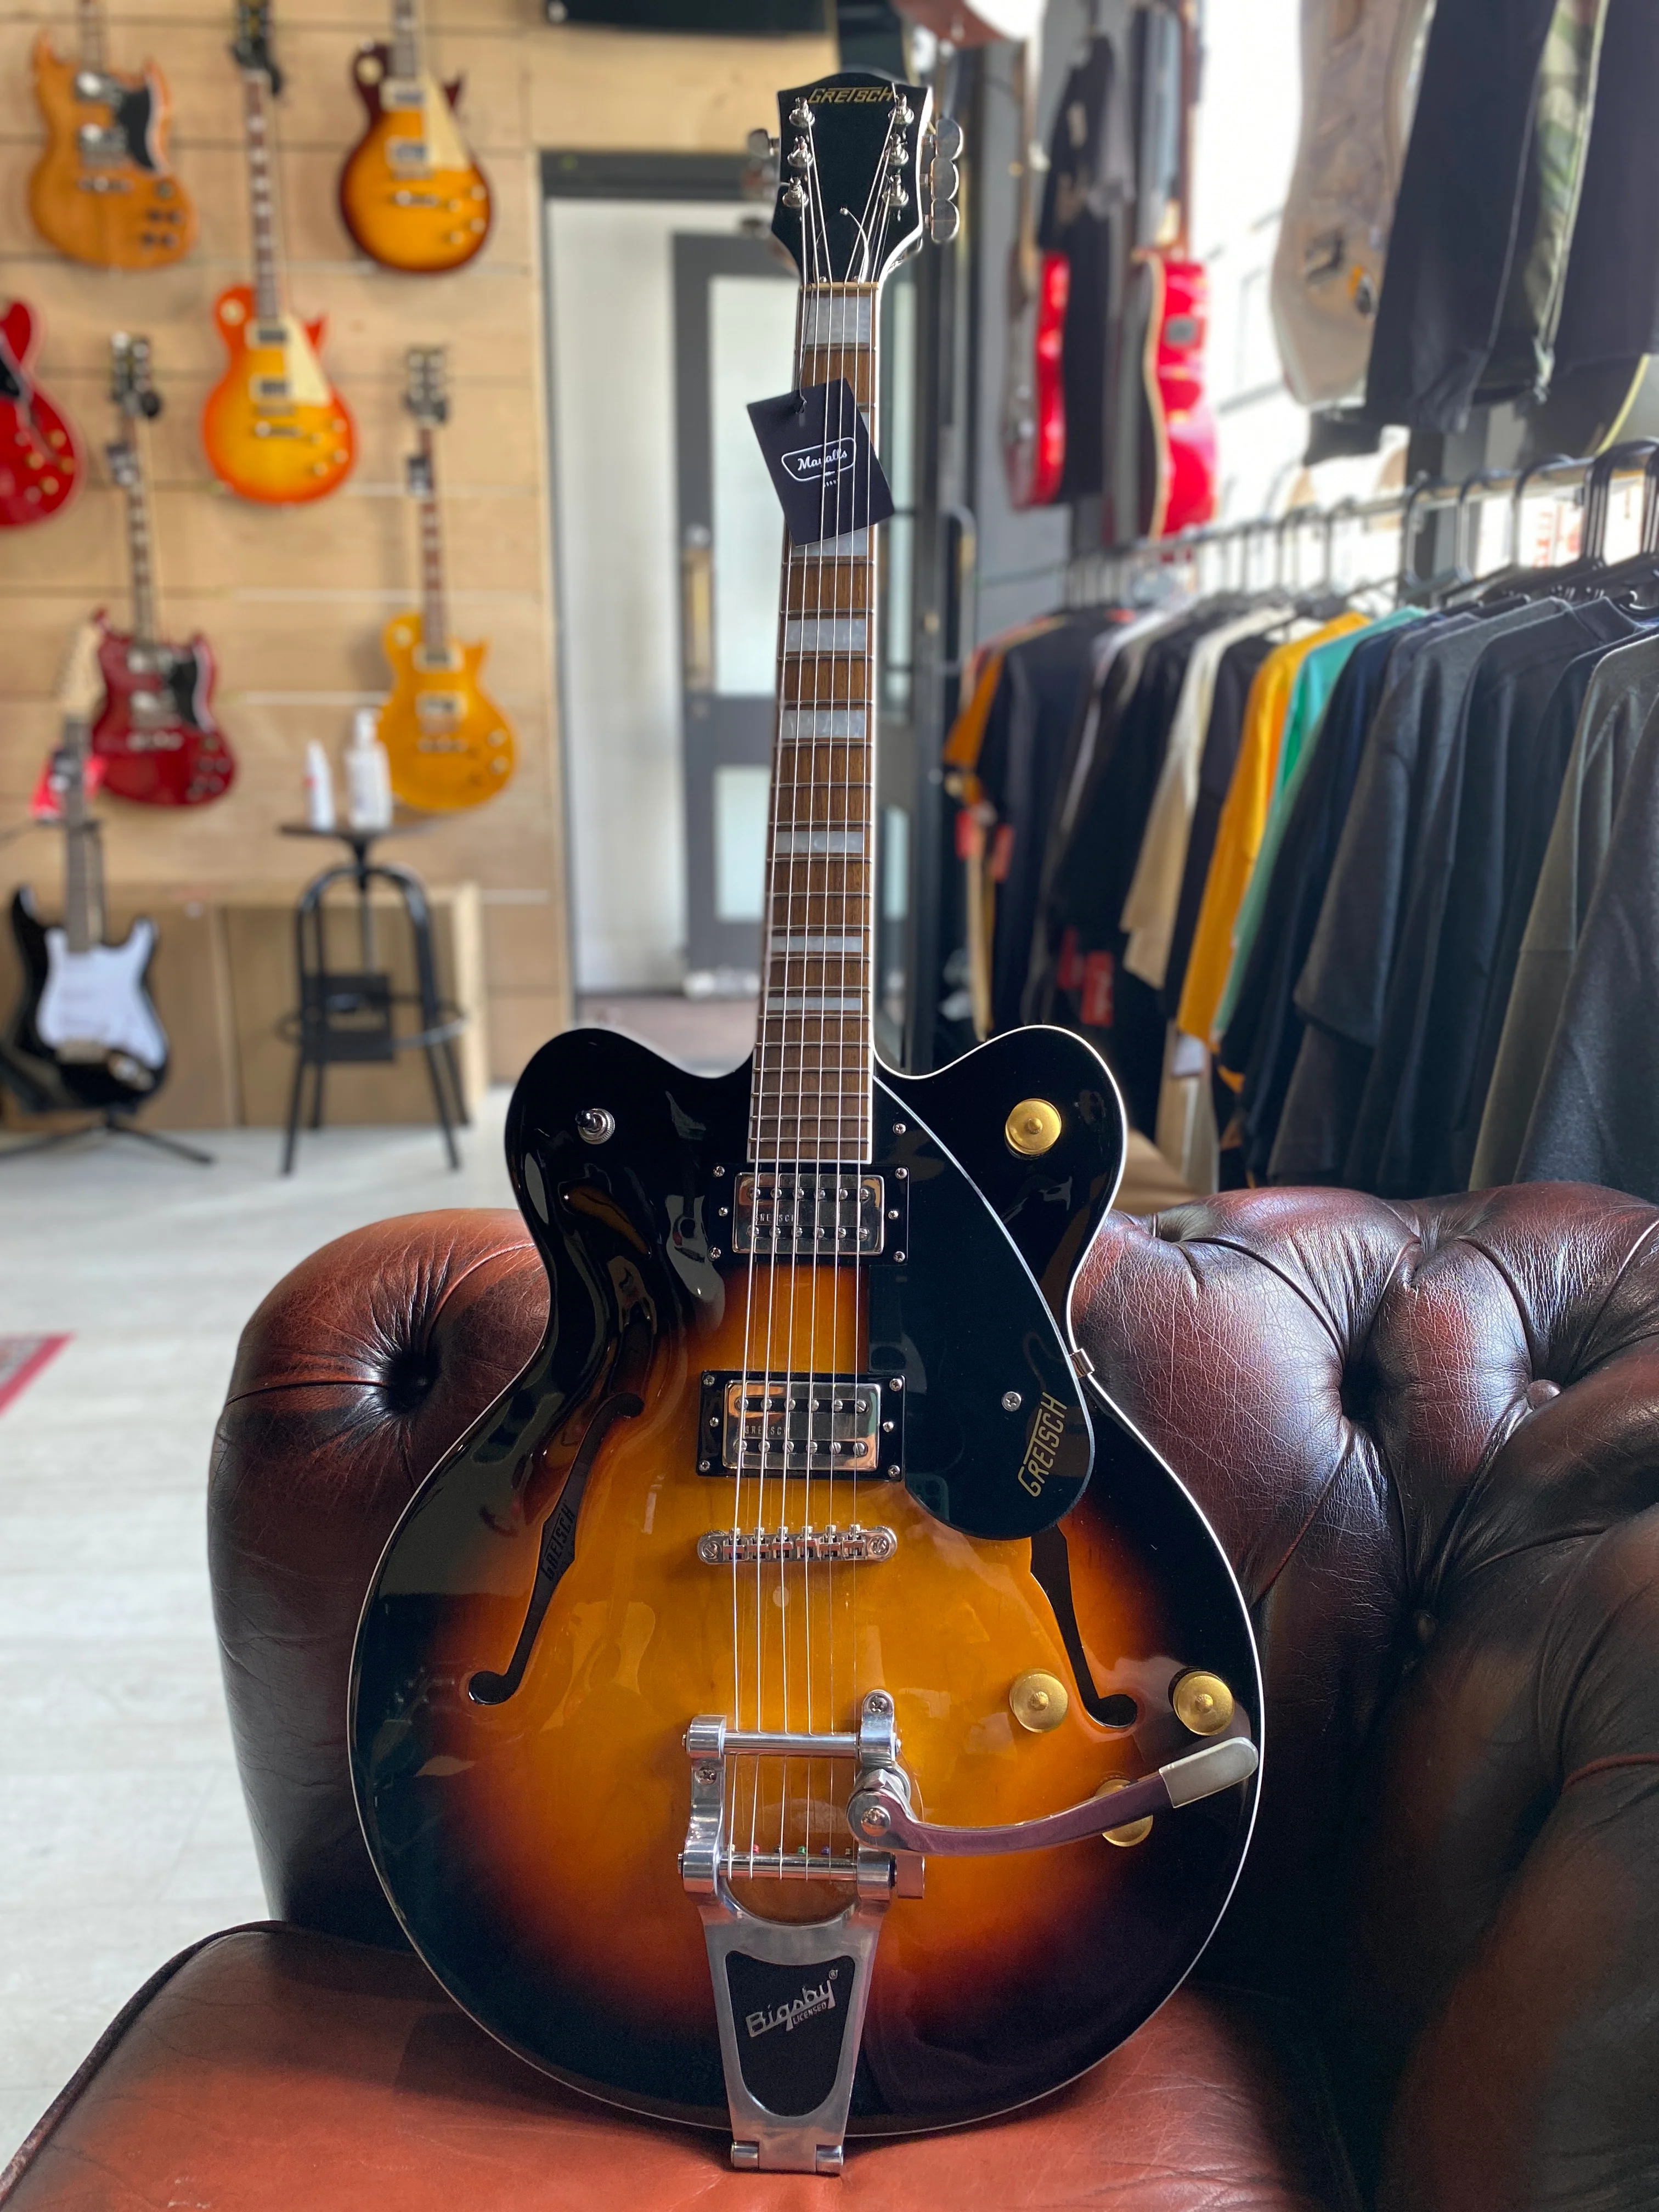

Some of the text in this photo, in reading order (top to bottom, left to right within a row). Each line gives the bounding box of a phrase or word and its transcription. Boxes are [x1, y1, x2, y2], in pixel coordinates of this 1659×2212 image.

[808, 86, 894, 104] GRETSCH
[754, 1213, 797, 1222] RESC
[744, 1425, 788, 1435] GRESC
[1018, 1391, 1068, 1497] GRETSCH
[540, 1502, 576, 1581] GRETSCH
[793, 2002, 827, 2024] LICENSED
